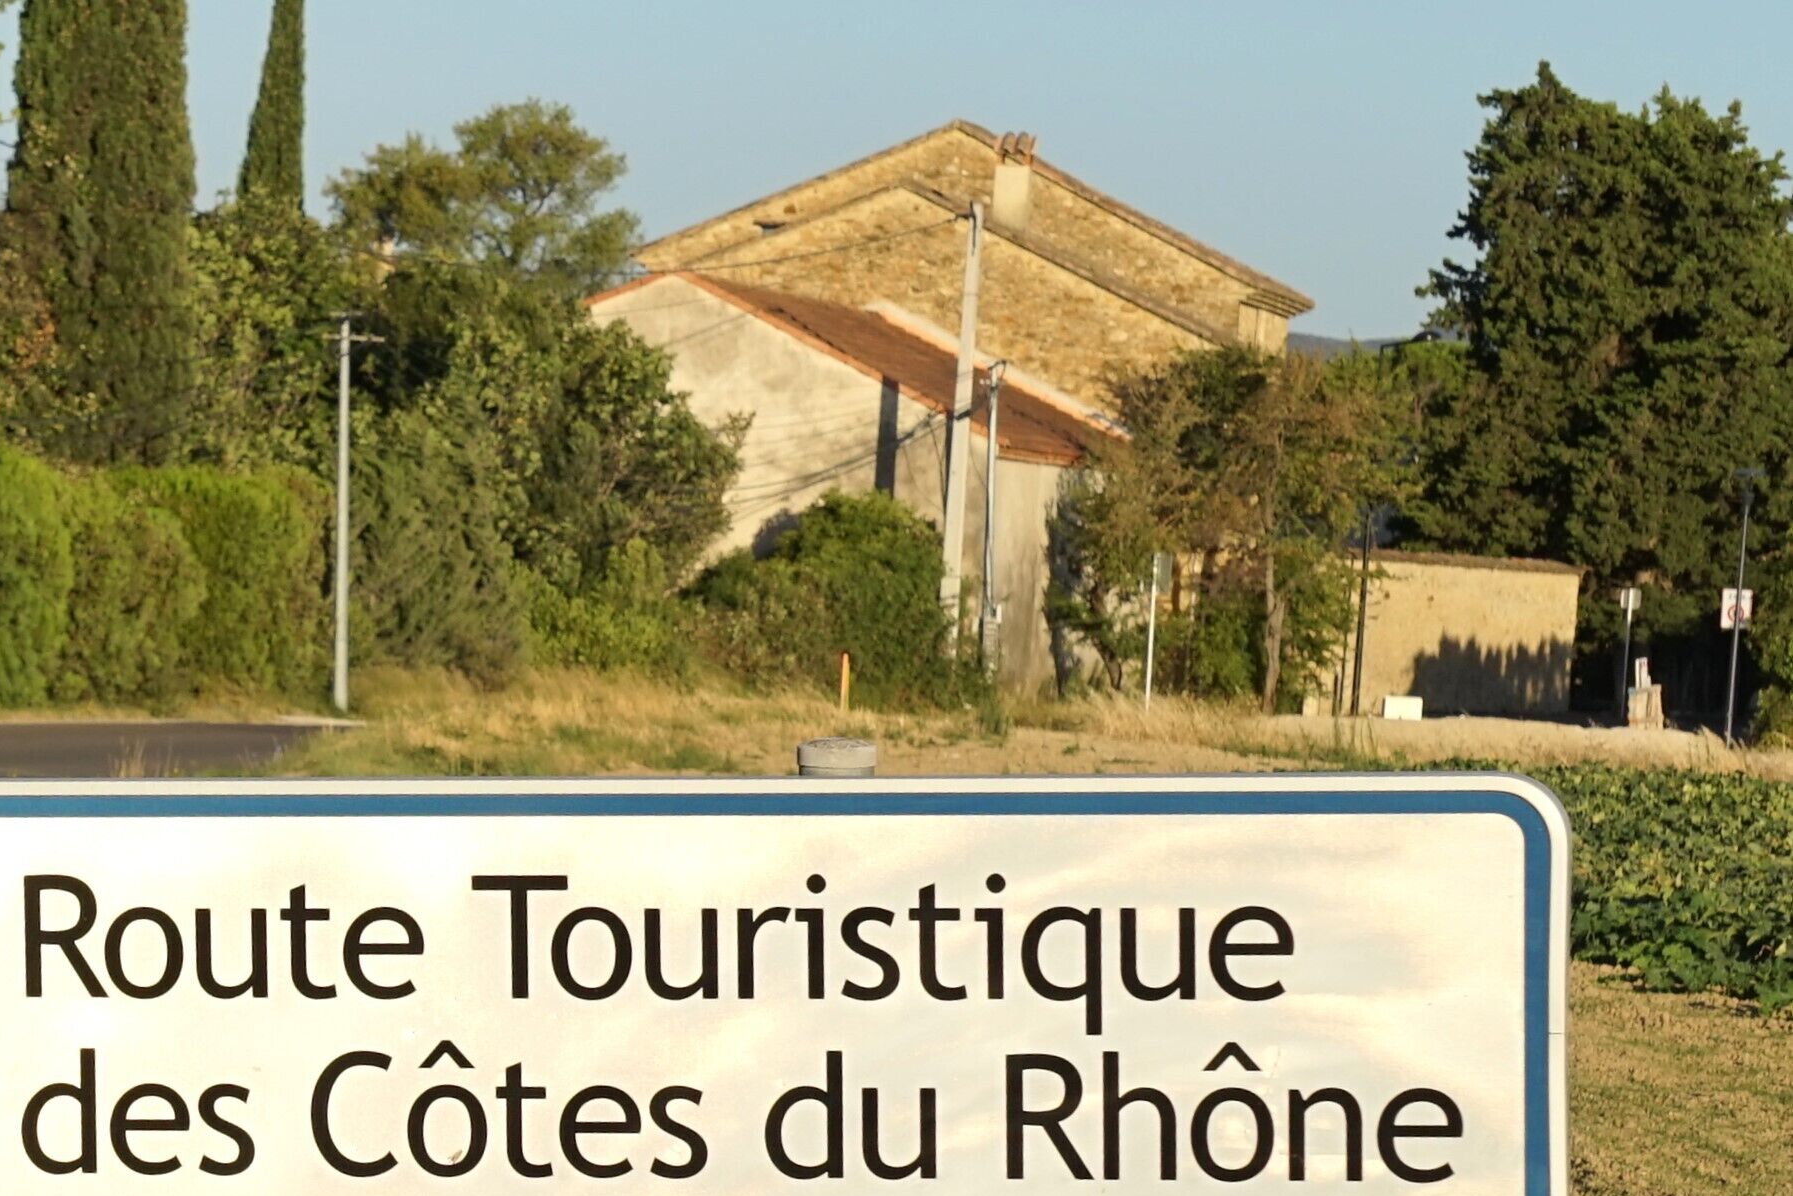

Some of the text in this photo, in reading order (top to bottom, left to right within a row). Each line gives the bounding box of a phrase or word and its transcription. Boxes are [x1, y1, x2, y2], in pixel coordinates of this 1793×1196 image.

[24, 873, 1294, 1036] Route Touristique
[22, 1040, 1464, 1184] des Côtes du Rhône
